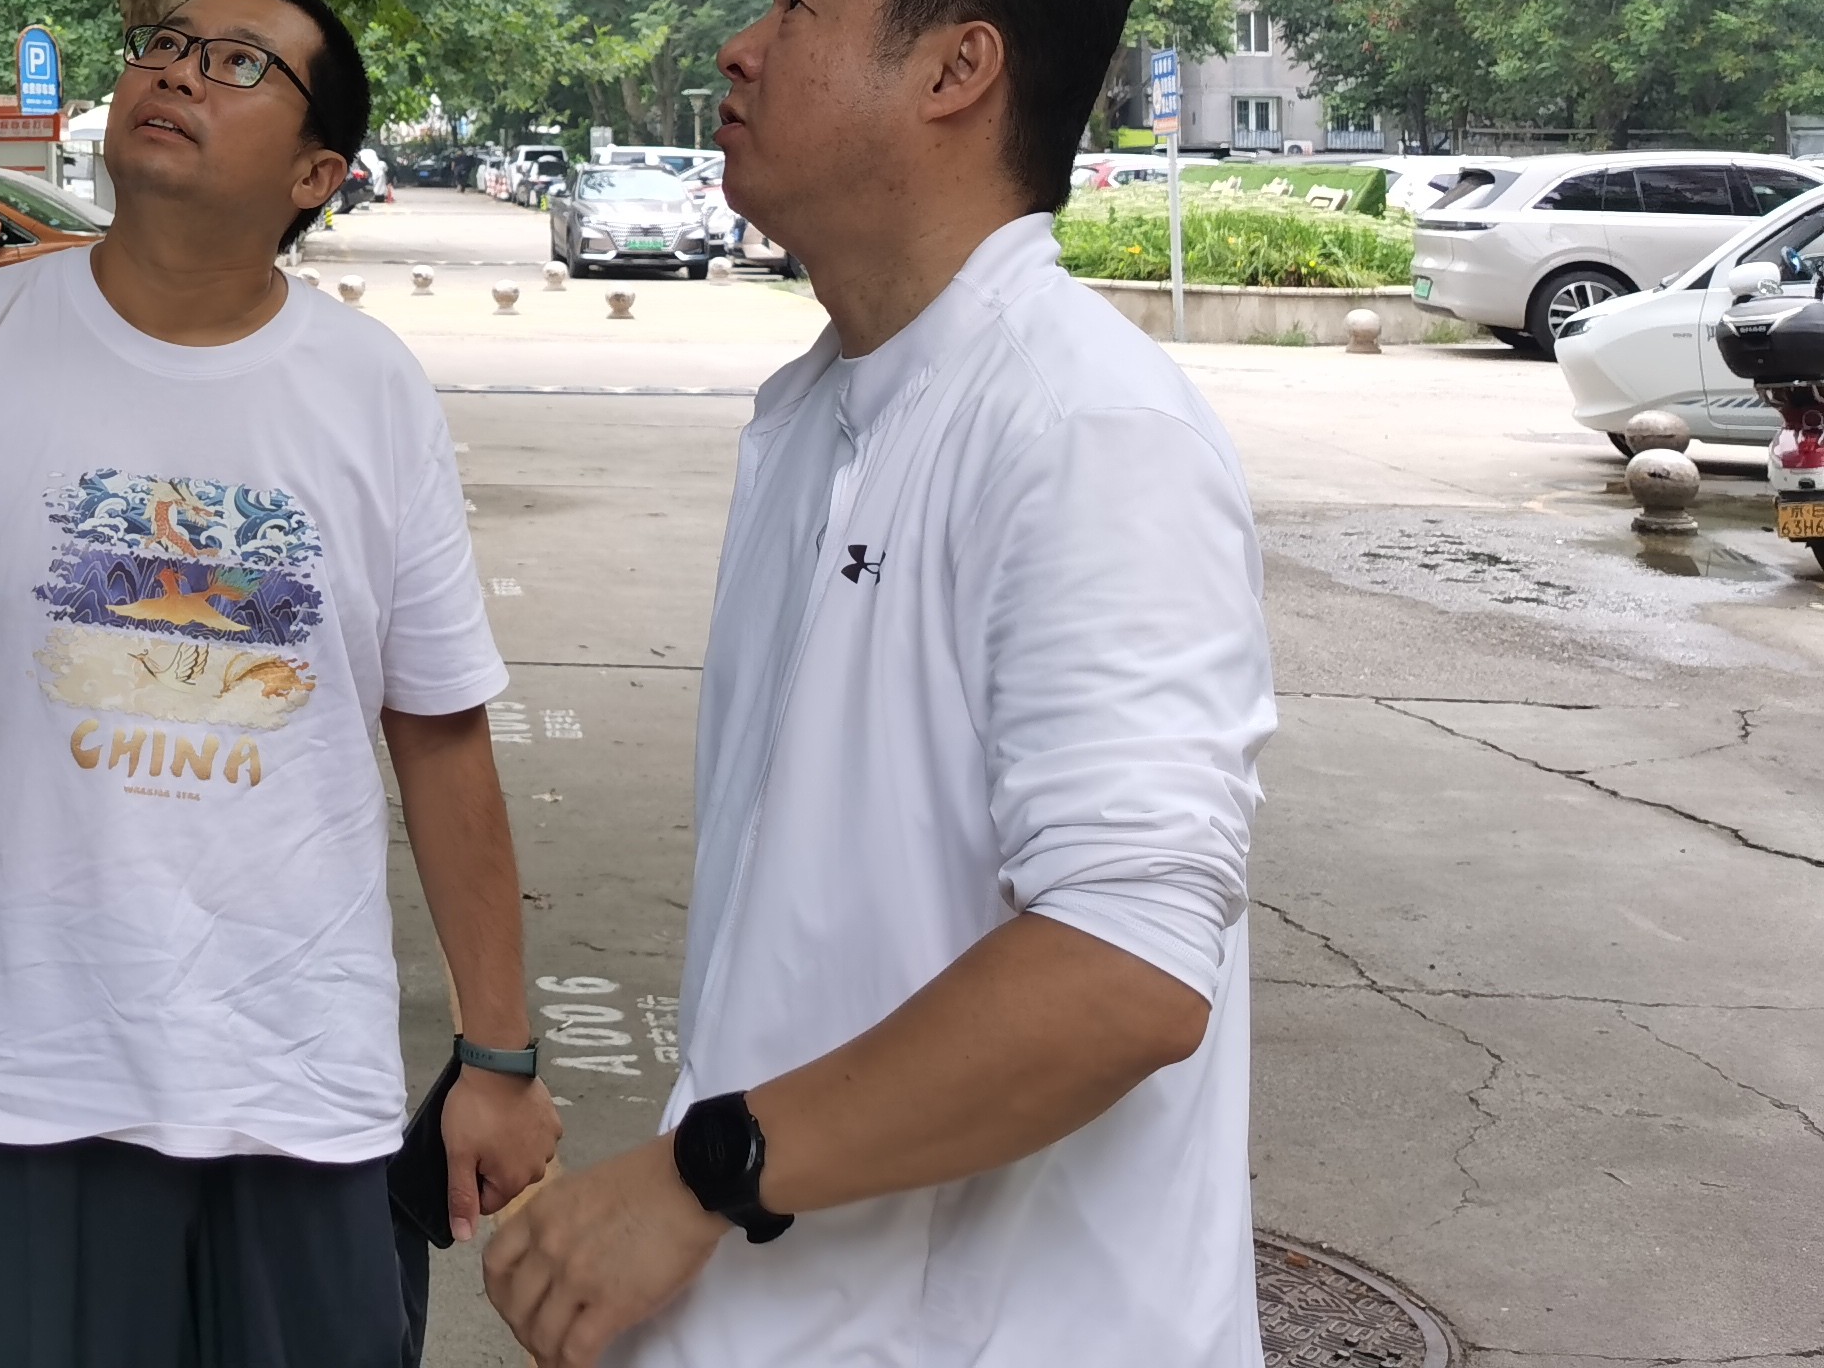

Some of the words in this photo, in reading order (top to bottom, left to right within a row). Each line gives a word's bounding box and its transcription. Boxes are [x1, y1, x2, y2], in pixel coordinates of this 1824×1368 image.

[29, 46, 45, 74] P
[70, 718, 262, 788] CHINA
[535, 976, 642, 1076] A006
